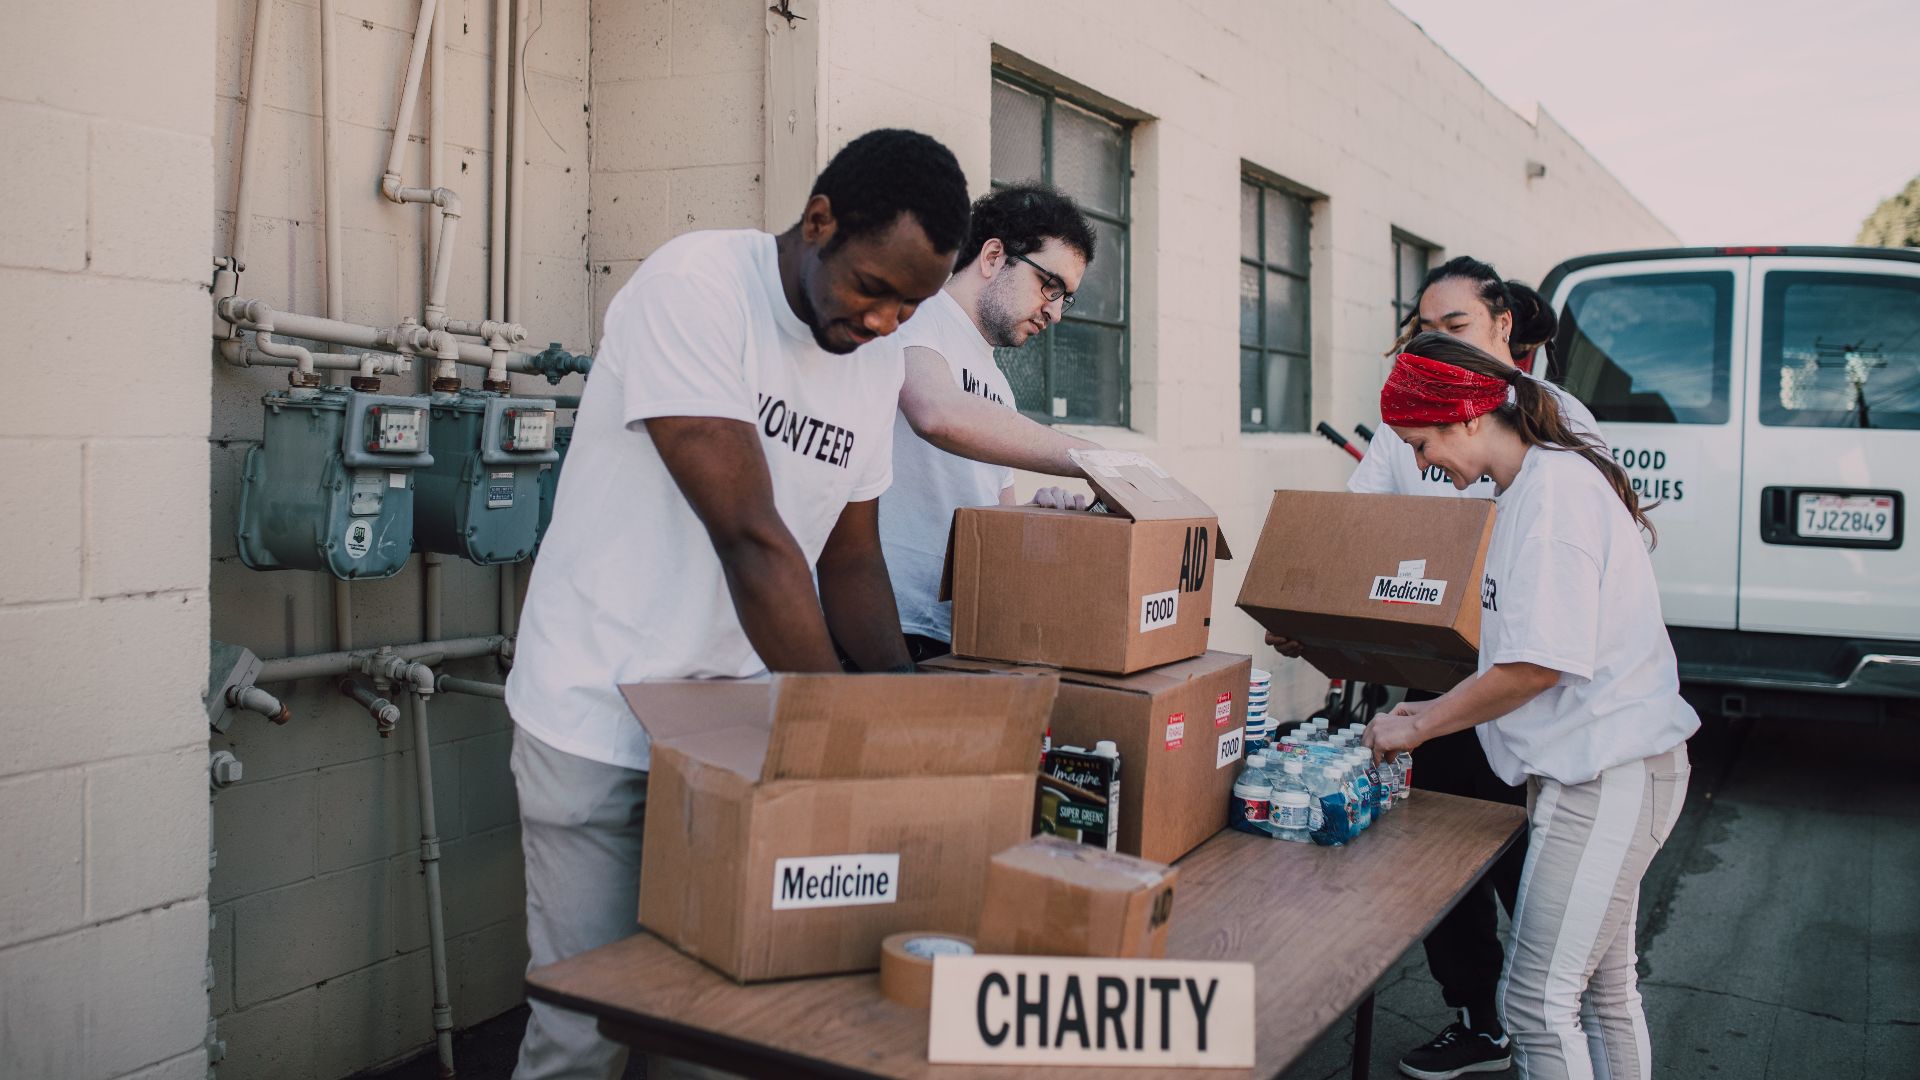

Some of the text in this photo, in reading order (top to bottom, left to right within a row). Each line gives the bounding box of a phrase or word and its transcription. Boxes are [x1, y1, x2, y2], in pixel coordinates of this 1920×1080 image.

[1612, 448, 1666, 470] FOOD
[1632, 478, 1684, 500] PLIES
[1806, 508, 1886, 533] 7J22849
[1178, 526, 1208, 594] AID
[1375, 578, 1439, 602] Medicine
[1145, 597, 1174, 624] FOOD
[1221, 737, 1239, 760] FOOD
[1052, 763, 1102, 790] Imagine
[1060, 805, 1080, 819] SUPER
[1081, 809, 1104, 825] GREENS
[780, 863, 890, 901] Medicine
[976, 971, 1219, 1051] CHARITY
